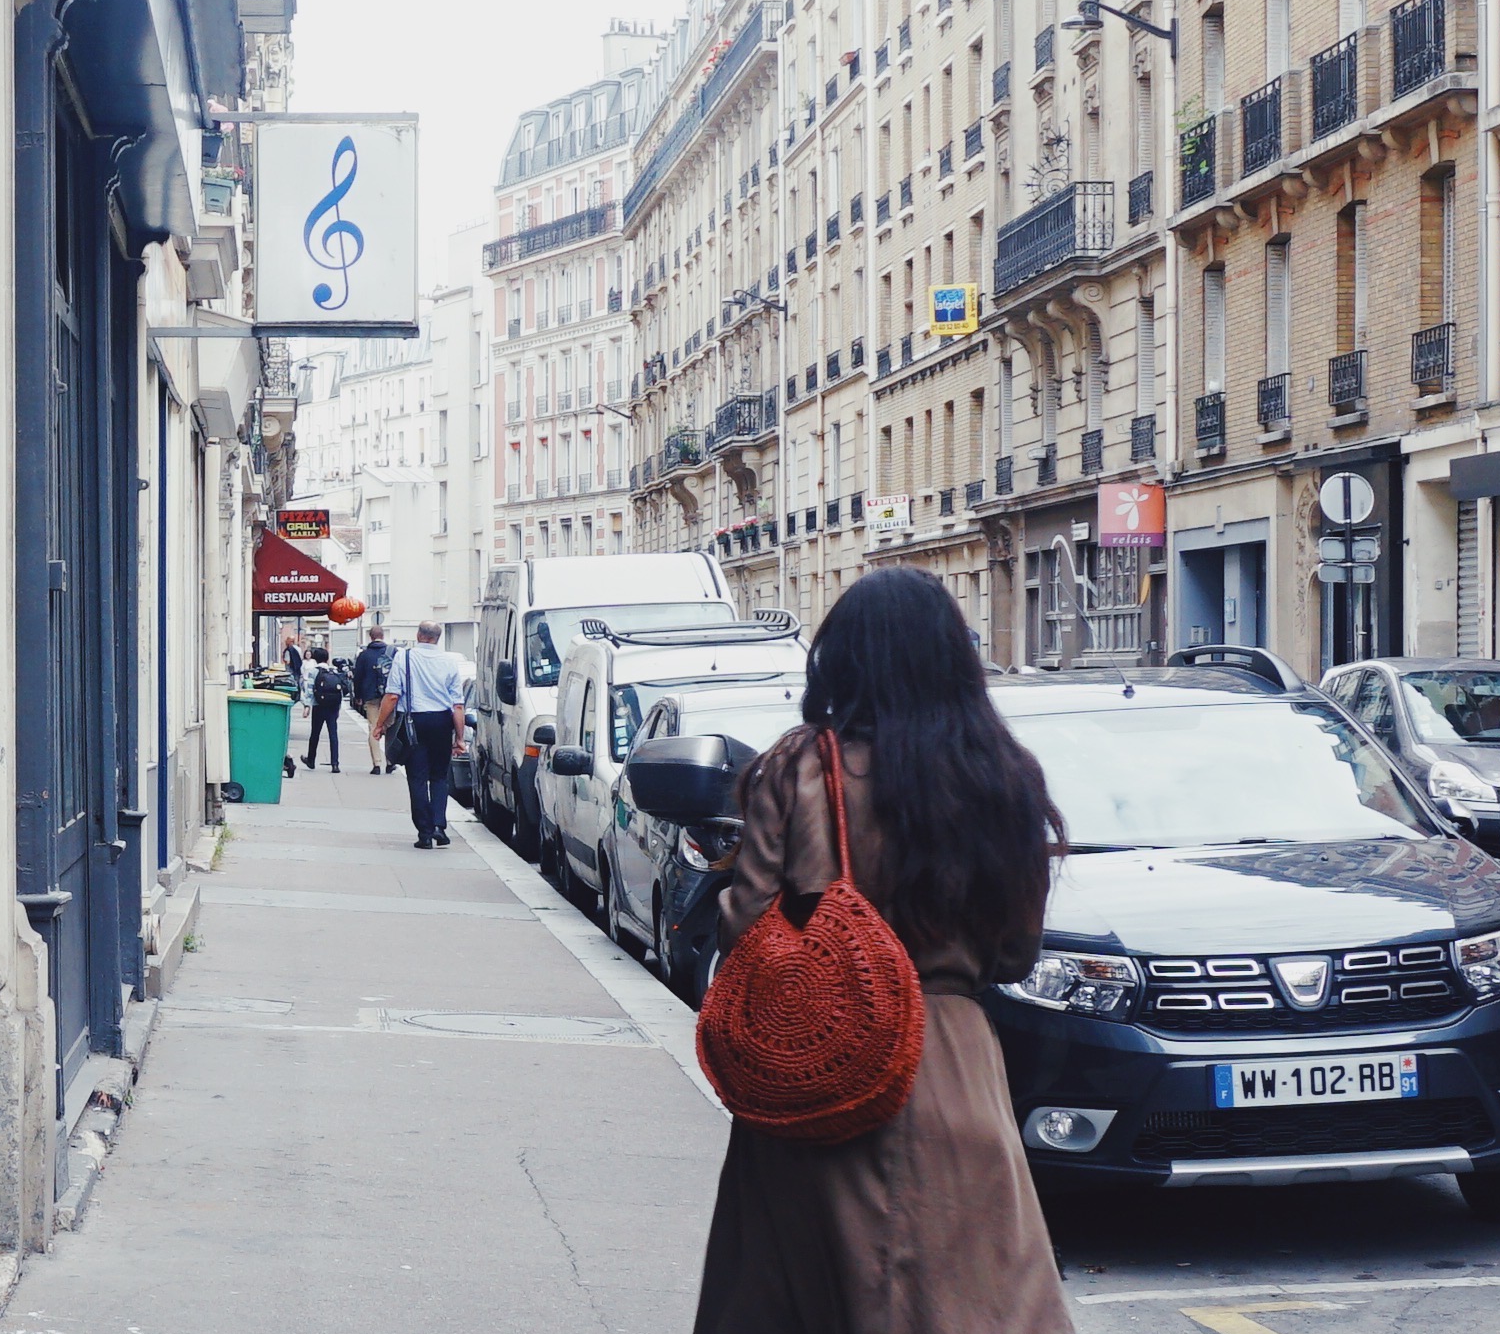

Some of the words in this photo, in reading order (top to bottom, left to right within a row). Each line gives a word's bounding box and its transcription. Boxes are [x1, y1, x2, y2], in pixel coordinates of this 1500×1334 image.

[280, 511, 326, 521] PIZZA
[286, 522, 320, 531] GRILL
[1112, 534, 1152, 544] relais
[264, 592, 336, 603] RESTAURANT
[1240, 1062, 1394, 1099] WW-102-RB
[1402, 1076, 1418, 1092] 91
[1221, 1090, 1228, 1099] F
